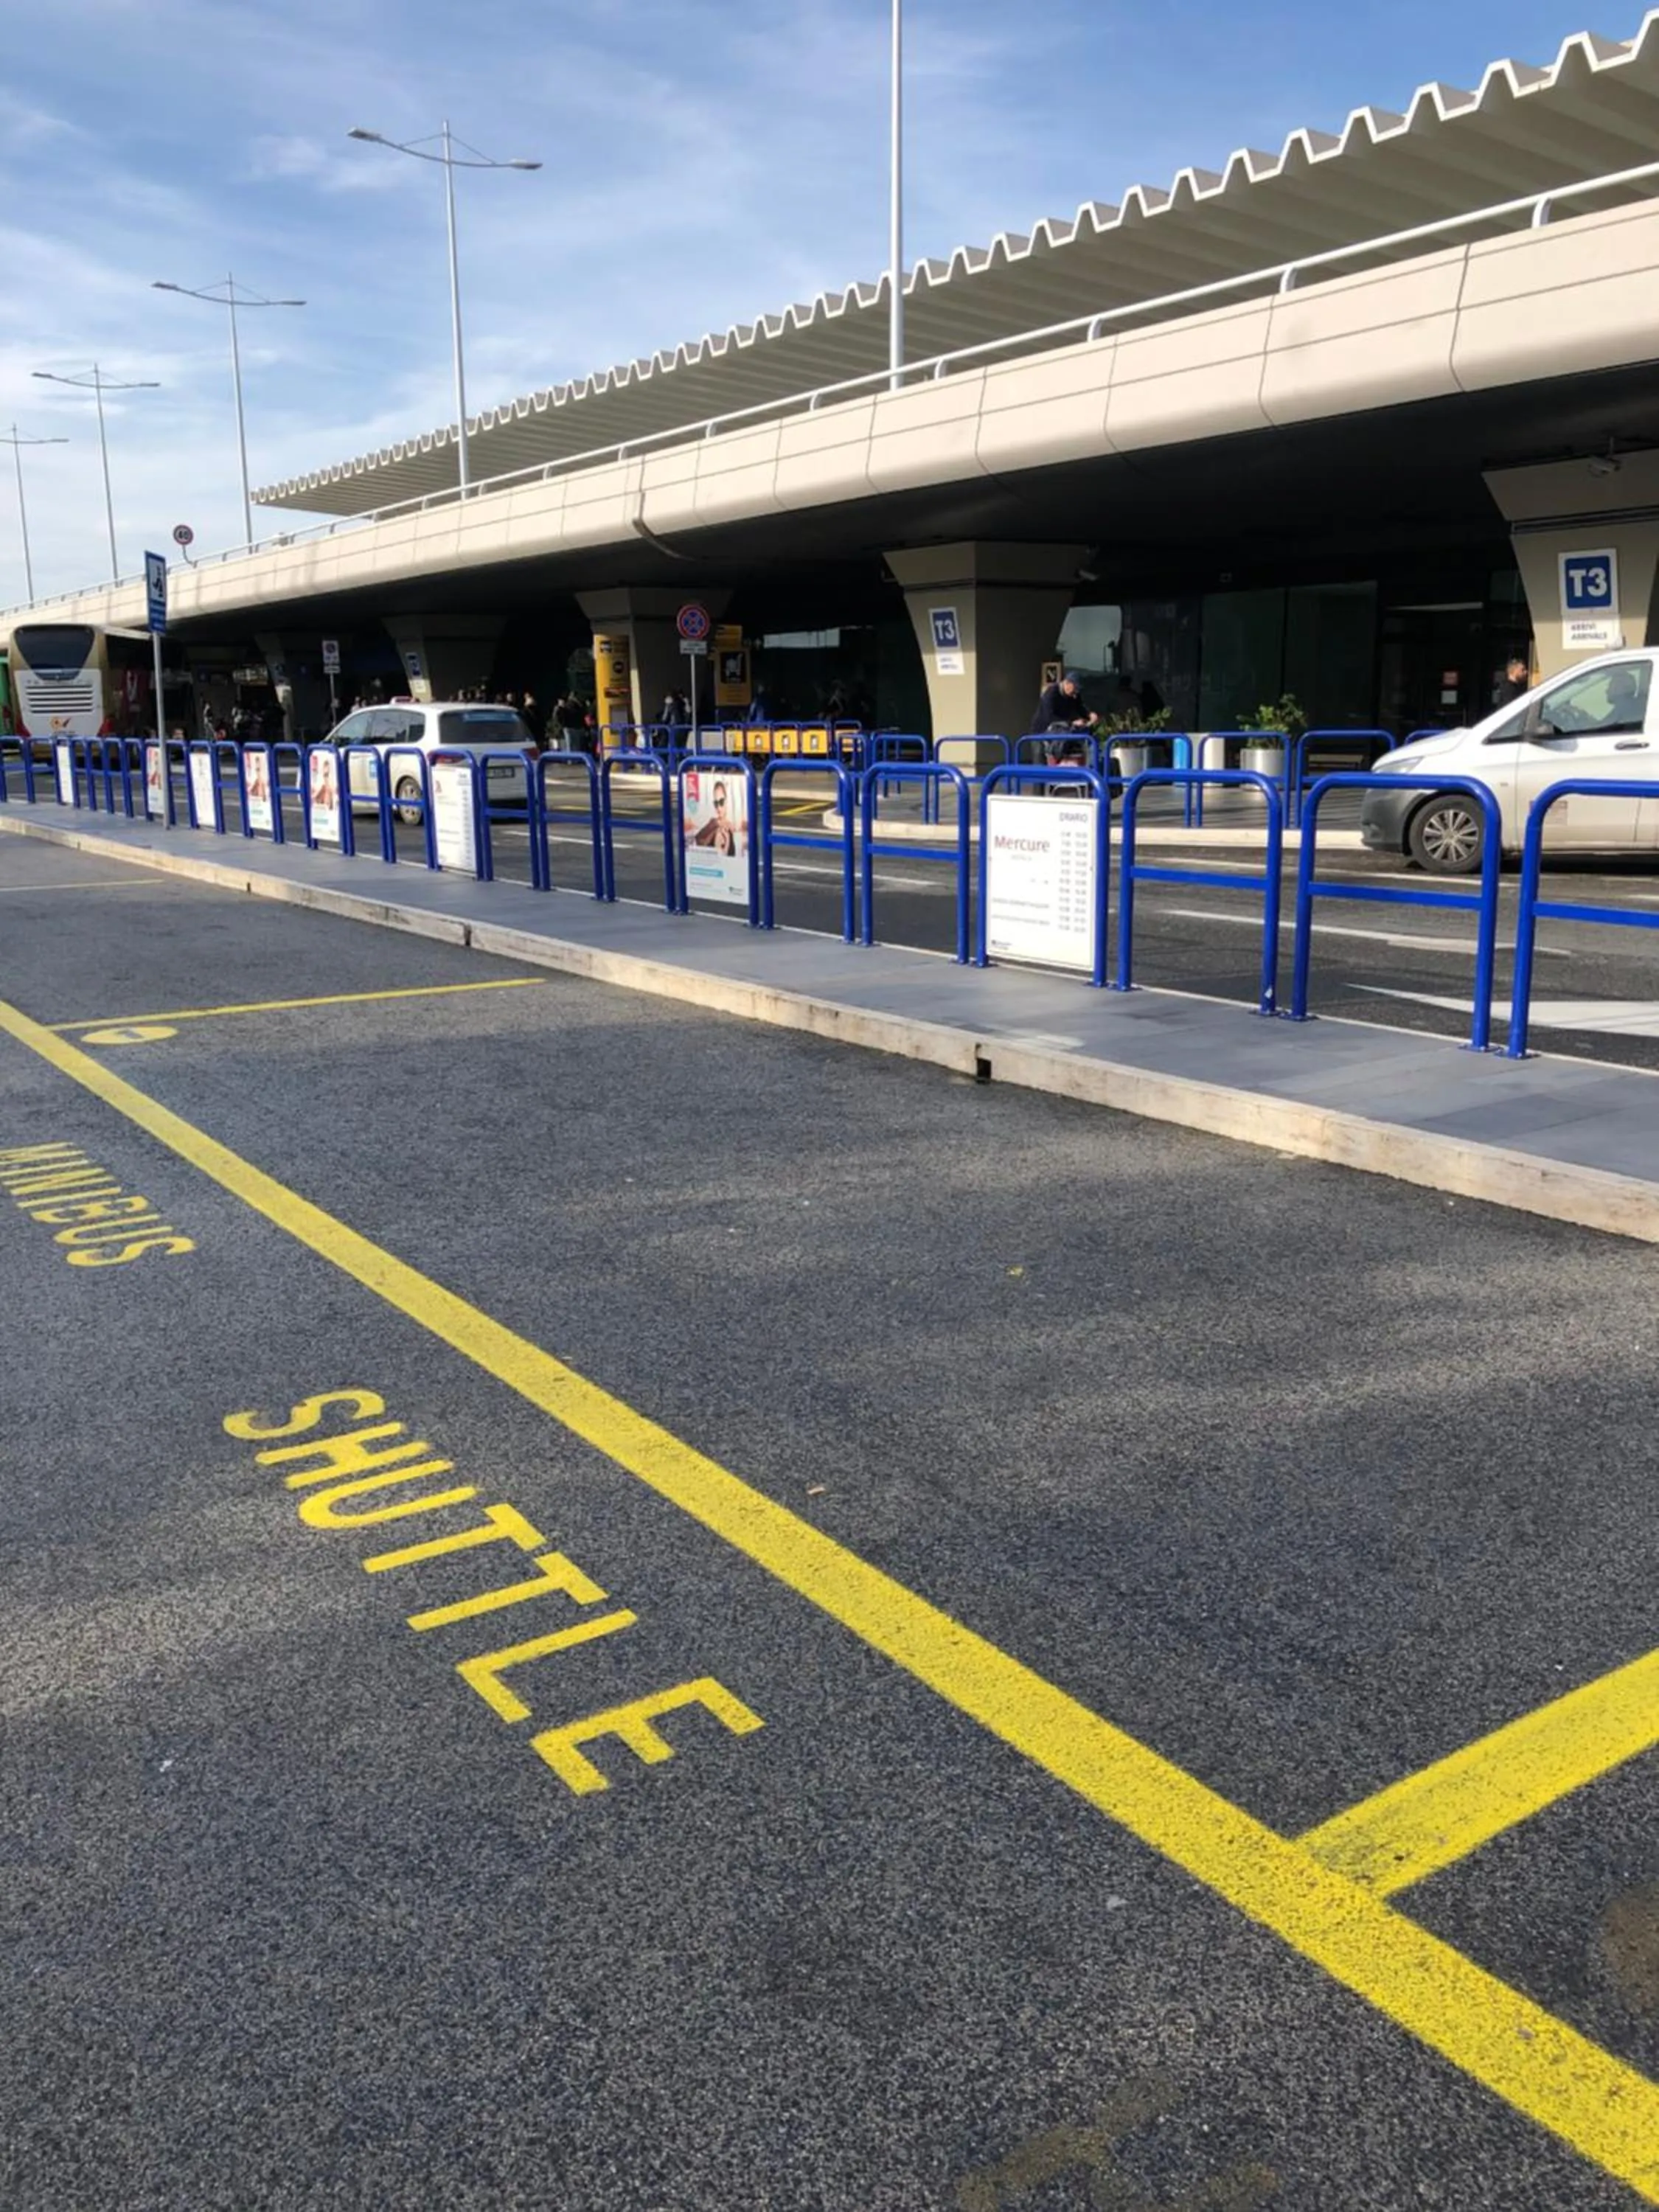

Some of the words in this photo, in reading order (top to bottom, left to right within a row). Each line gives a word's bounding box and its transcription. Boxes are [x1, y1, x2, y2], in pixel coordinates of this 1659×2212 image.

[1568, 567, 1607, 597] T3
[935, 619, 955, 640] T3
[995, 835, 1050, 852] Mercure
[223, 1389, 765, 1797] SHUTTLE
